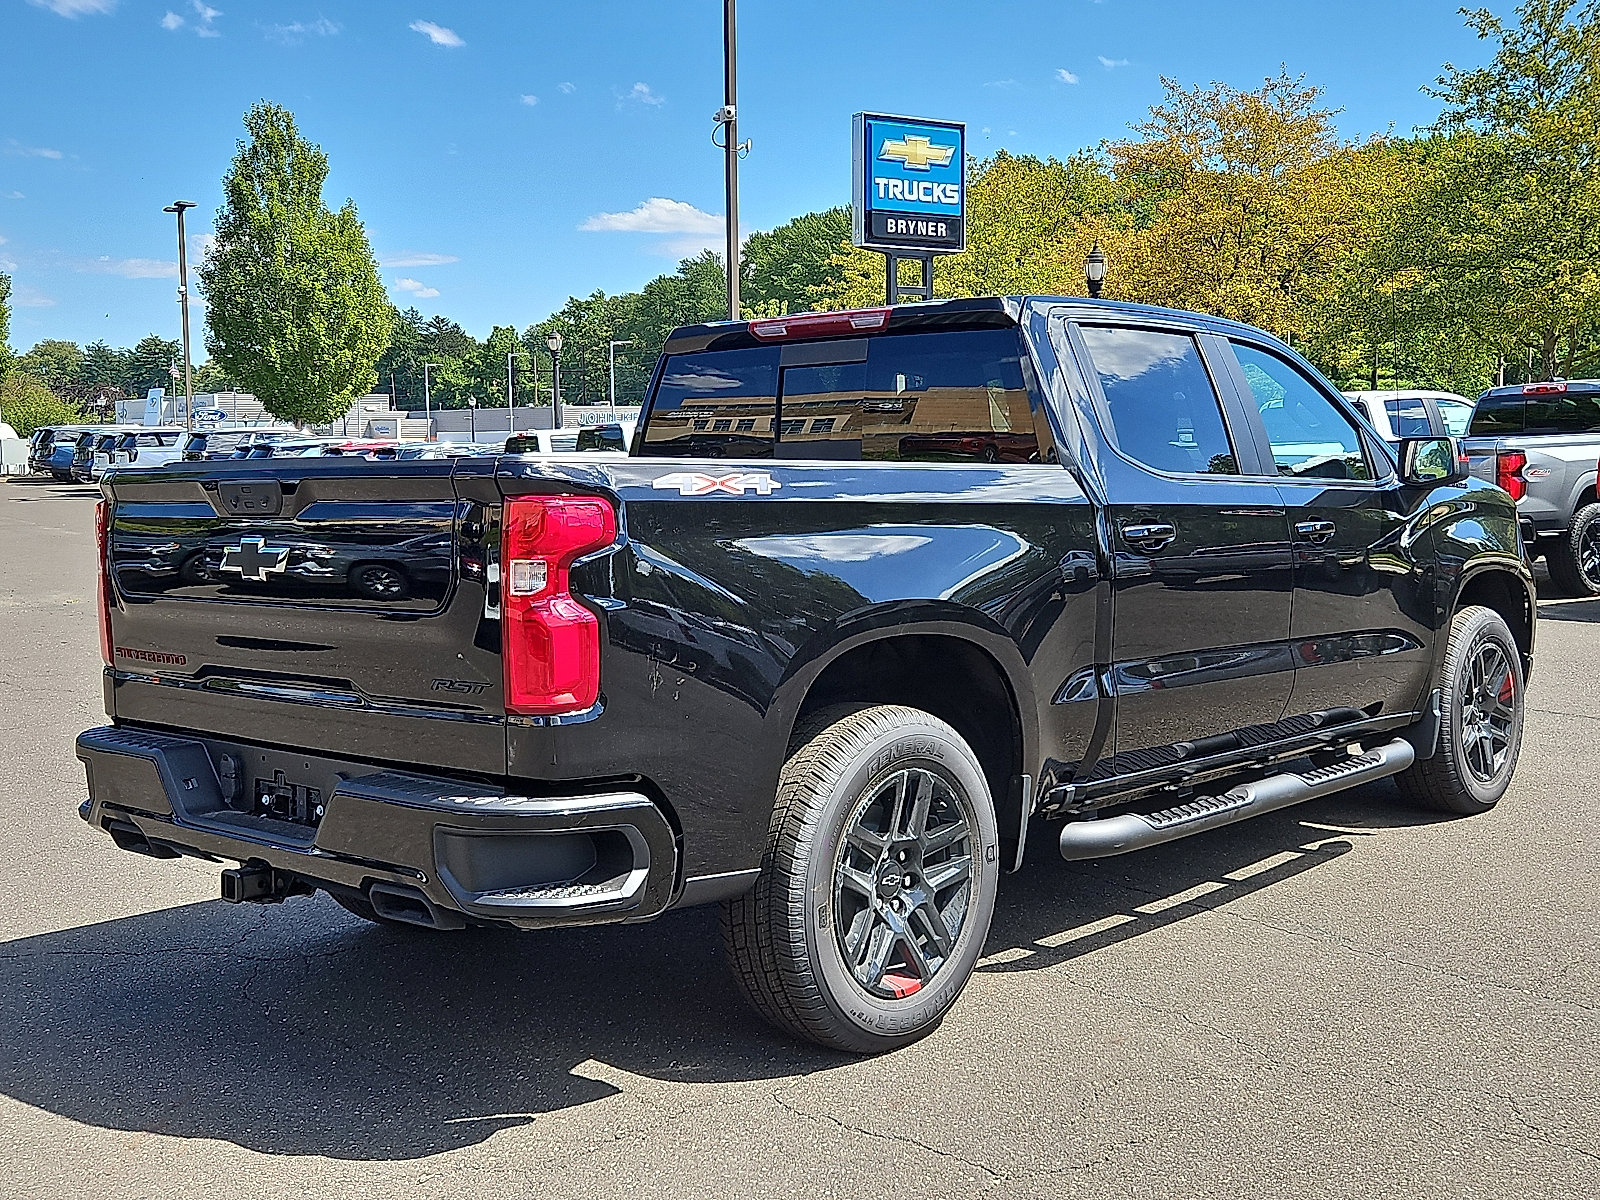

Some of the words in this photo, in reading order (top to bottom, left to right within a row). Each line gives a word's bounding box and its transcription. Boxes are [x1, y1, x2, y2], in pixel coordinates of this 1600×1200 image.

[874, 177, 960, 205] TRUCKS
[886, 218, 948, 237] BRYNER
[580, 412, 617, 424] JOHN
[430, 678, 495, 696] RST
[866, 739, 945, 780] GENERAL
